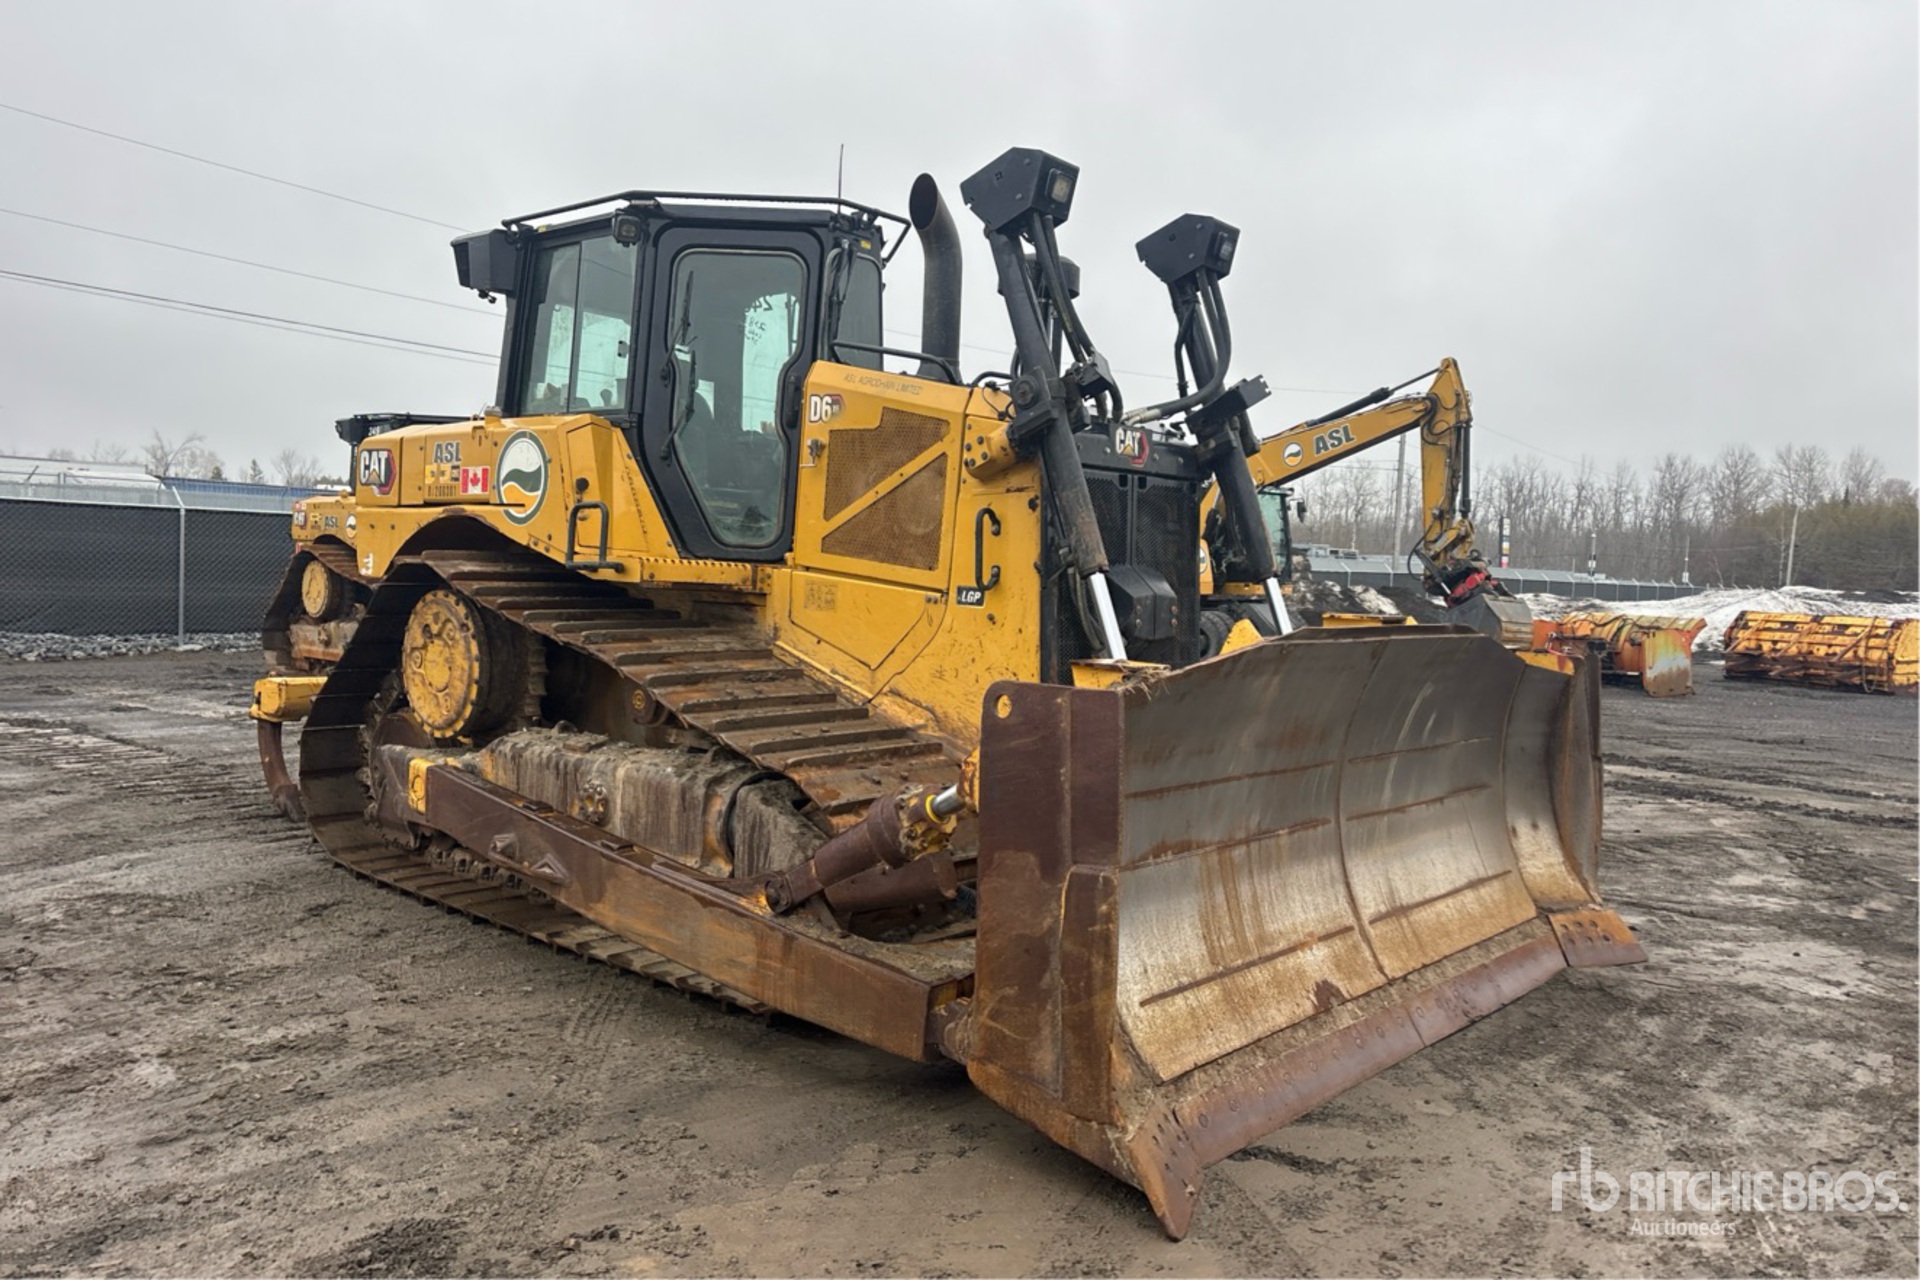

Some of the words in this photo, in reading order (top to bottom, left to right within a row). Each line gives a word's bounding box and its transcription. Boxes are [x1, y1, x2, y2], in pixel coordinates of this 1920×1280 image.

[809, 394, 832, 423] D6
[433, 441, 462, 464] ASL
[1115, 428, 1141, 456] CAT
[1313, 424, 1356, 456] ASL
[360, 450, 388, 485] CAT
[324, 514, 340, 529] ASL
[961, 590, 982, 603] LGP
